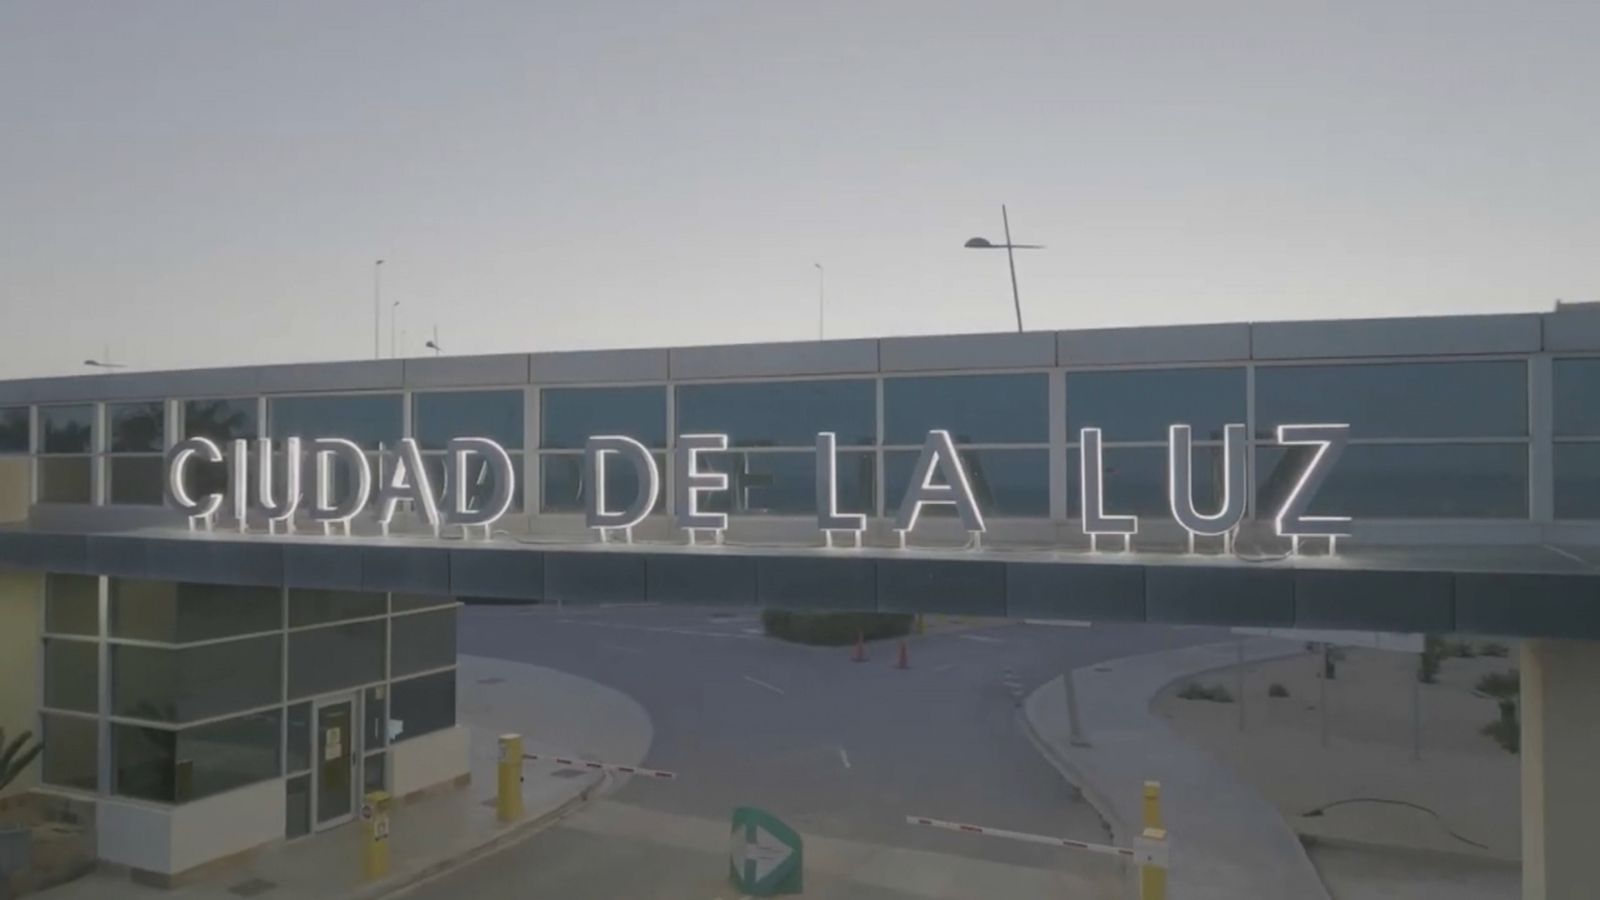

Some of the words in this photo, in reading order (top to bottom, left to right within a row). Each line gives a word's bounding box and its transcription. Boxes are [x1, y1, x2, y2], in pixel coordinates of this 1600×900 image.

[166, 436, 515, 526] CIUDAD
[586, 434, 728, 531] DE
[815, 429, 986, 533] LA
[1080, 423, 1352, 537] LUZ
